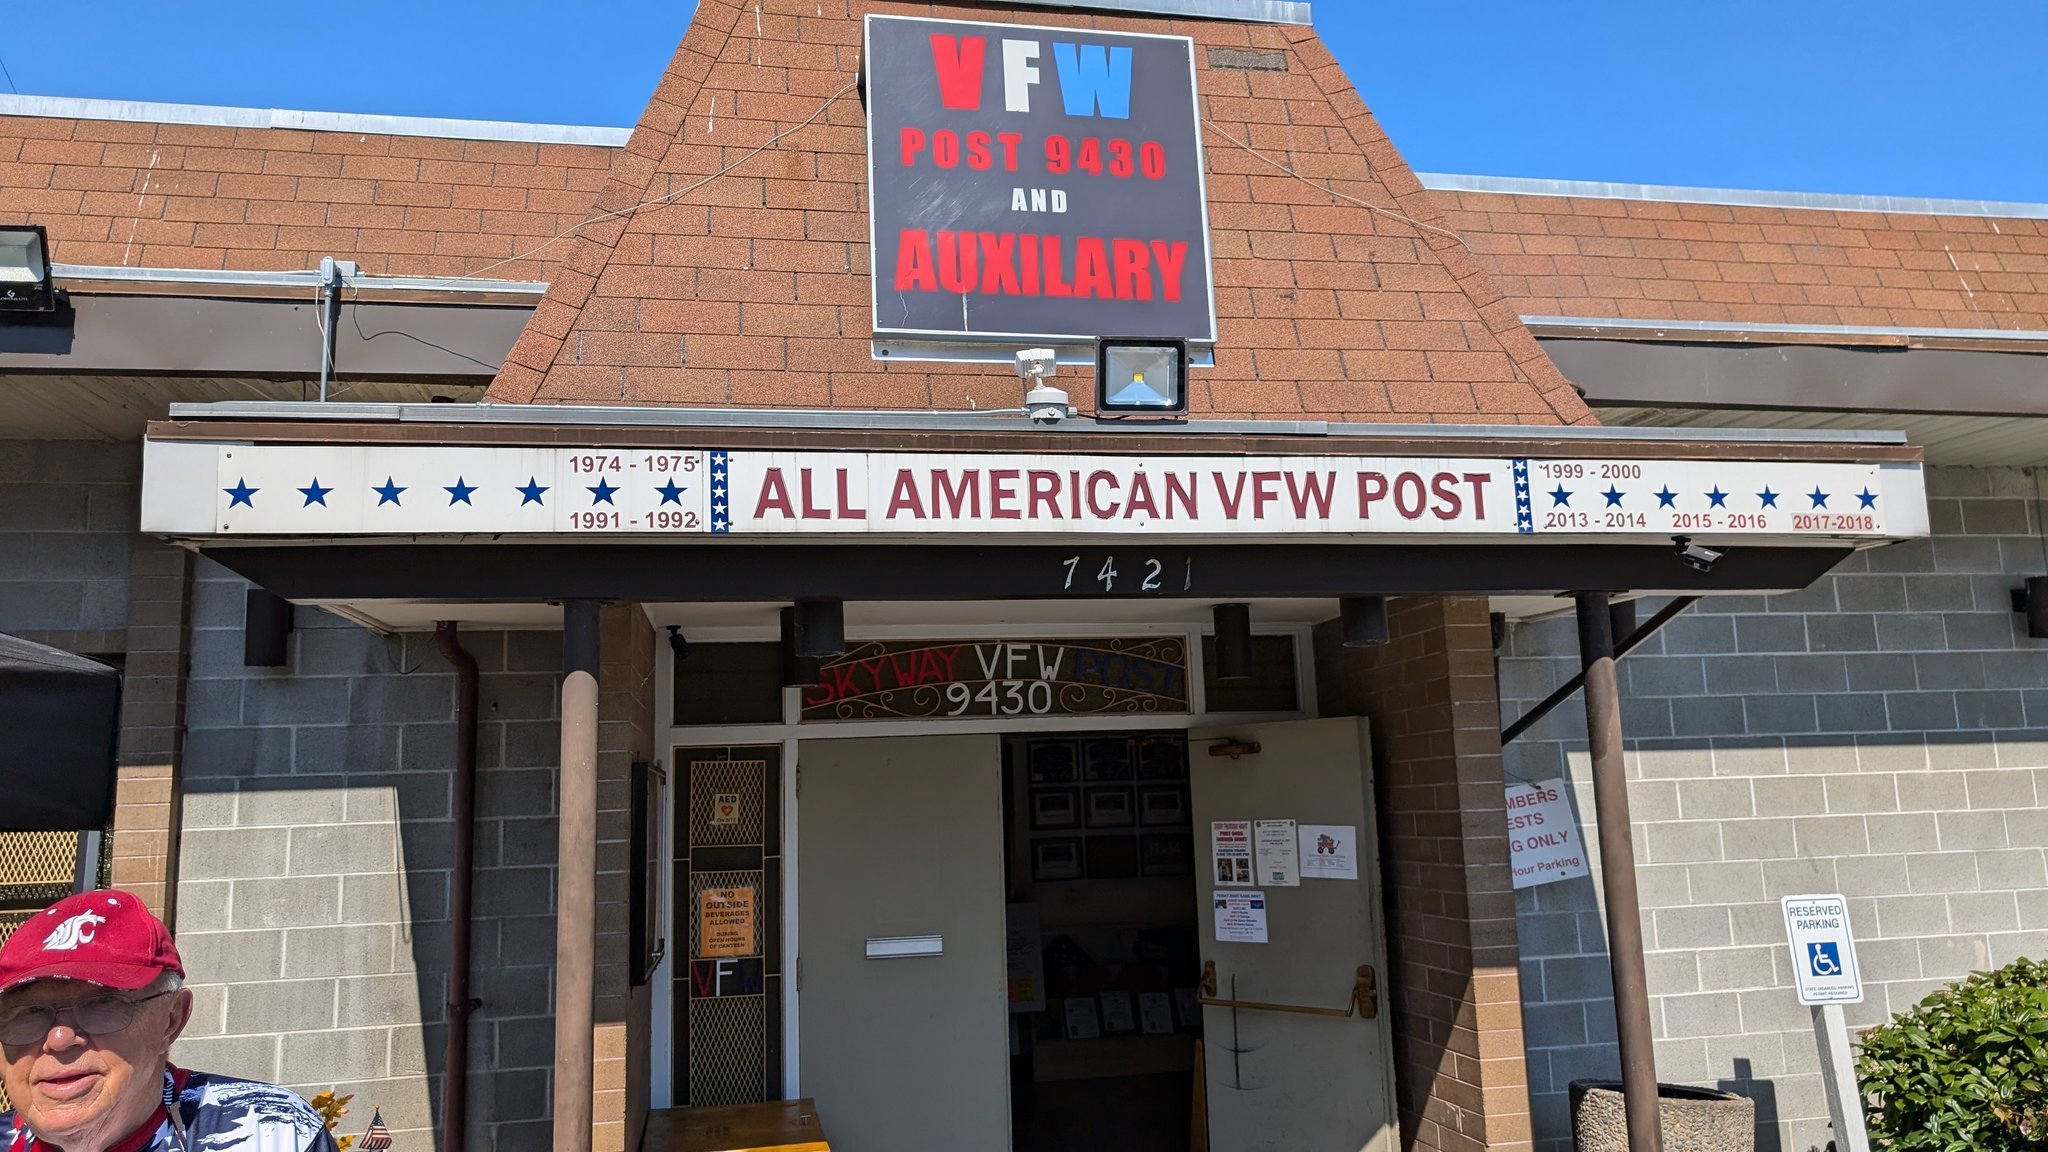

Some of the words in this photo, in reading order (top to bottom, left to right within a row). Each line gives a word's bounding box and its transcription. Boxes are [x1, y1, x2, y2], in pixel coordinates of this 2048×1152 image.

[930, 33, 1133, 120] VFW
[900, 127, 1023, 172] POST
[1045, 134, 1166, 181] 9430
[1011, 187, 1068, 213] AND
[894, 229, 1188, 303] AUXILARY
[569, 456, 621, 473] 1974
[644, 455, 696, 472] 1975
[1543, 464, 1584, 479] 1999
[1601, 464, 1641, 479] 2000
[753, 467, 868, 520] ALL
[886, 468, 1198, 520] AMERICAN
[1211, 471, 1338, 520] VFW
[1356, 470, 1492, 521] POST
[569, 512, 620, 529] 1991
[645, 511, 697, 529] 1992
[1546, 512, 1589, 528] 2013
[1605, 512, 1647, 528] 2014
[1672, 513, 1712, 528] 2015
[1727, 514, 1767, 529] 2016
[1794, 514, 1873, 530] 2017-2018
[1063, 556, 1192, 592] 7421
[806, 646, 961, 706] SKYWAY
[974, 643, 1066, 681] VFW
[1073, 647, 1185, 698] POST
[946, 681, 1052, 716] 9430
[718, 795, 738, 804] AED
[1511, 839, 1524, 853] G
[1527, 830, 1569, 850] ONLY
[1537, 857, 1580, 873] Parking
[720, 890, 735, 898] NO
[705, 900, 749, 909] OUTSIDE
[1789, 905, 1842, 917] RESERVED
[705, 910, 750, 918] BEVERAGES
[709, 918, 745, 926] ALLOWED
[1796, 918, 1840, 930] PARKING
